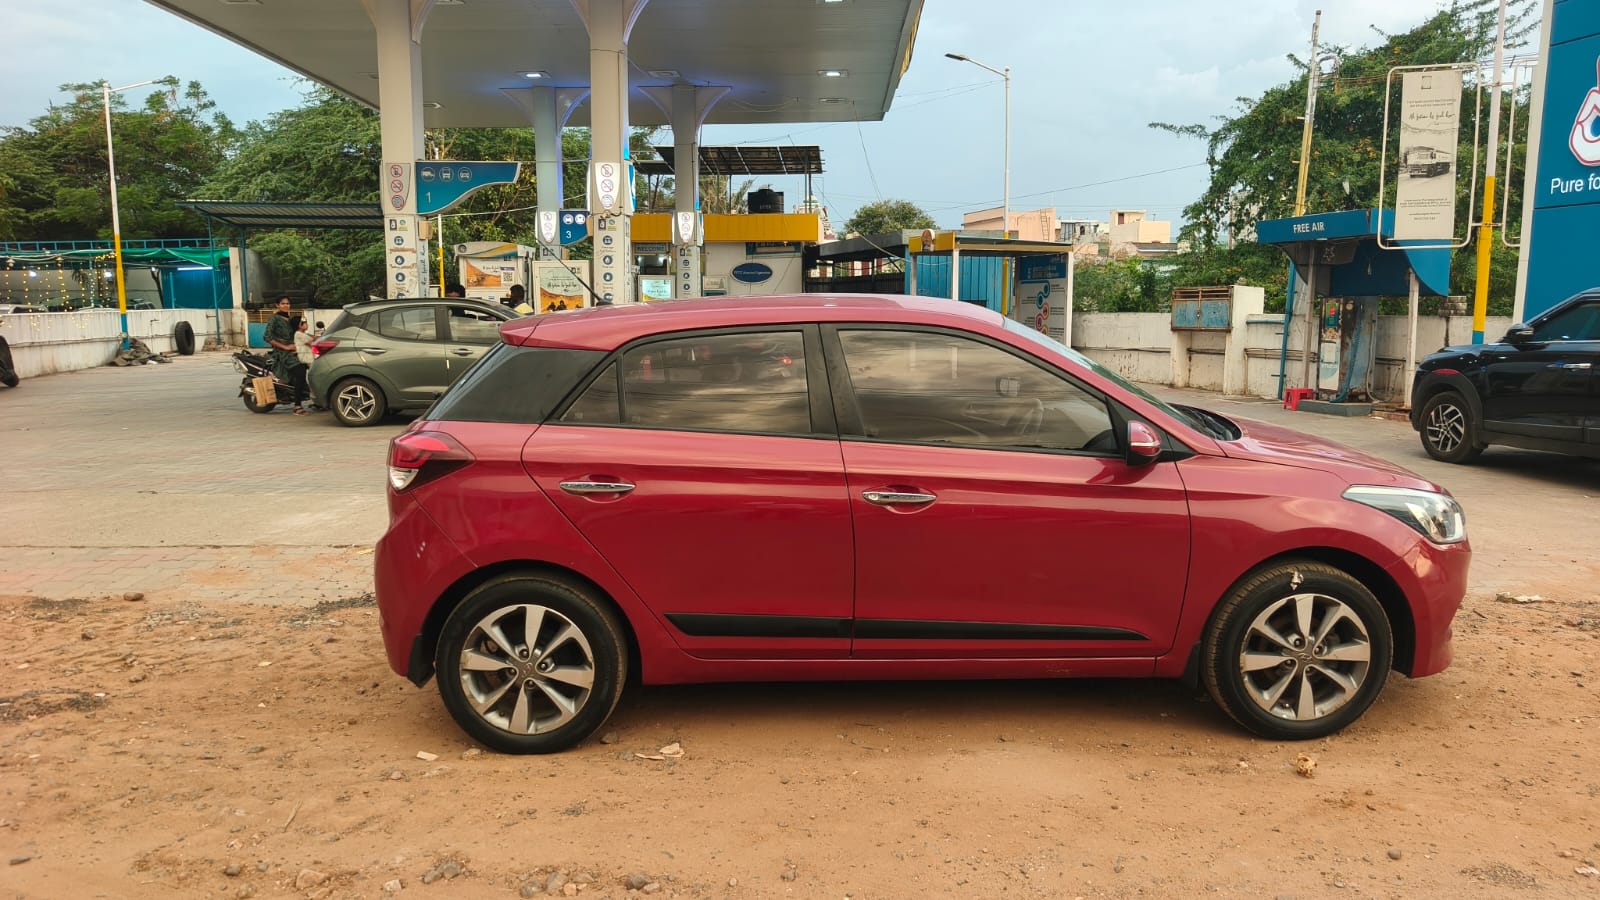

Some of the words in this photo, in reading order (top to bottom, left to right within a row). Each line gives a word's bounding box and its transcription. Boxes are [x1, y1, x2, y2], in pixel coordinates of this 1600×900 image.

[1550, 177, 1584, 196] Pure
[425, 191, 431, 204] 1
[1293, 223, 1310, 234] FREE
[1311, 221, 1325, 232] AIR
[565, 230, 572, 239] 3
